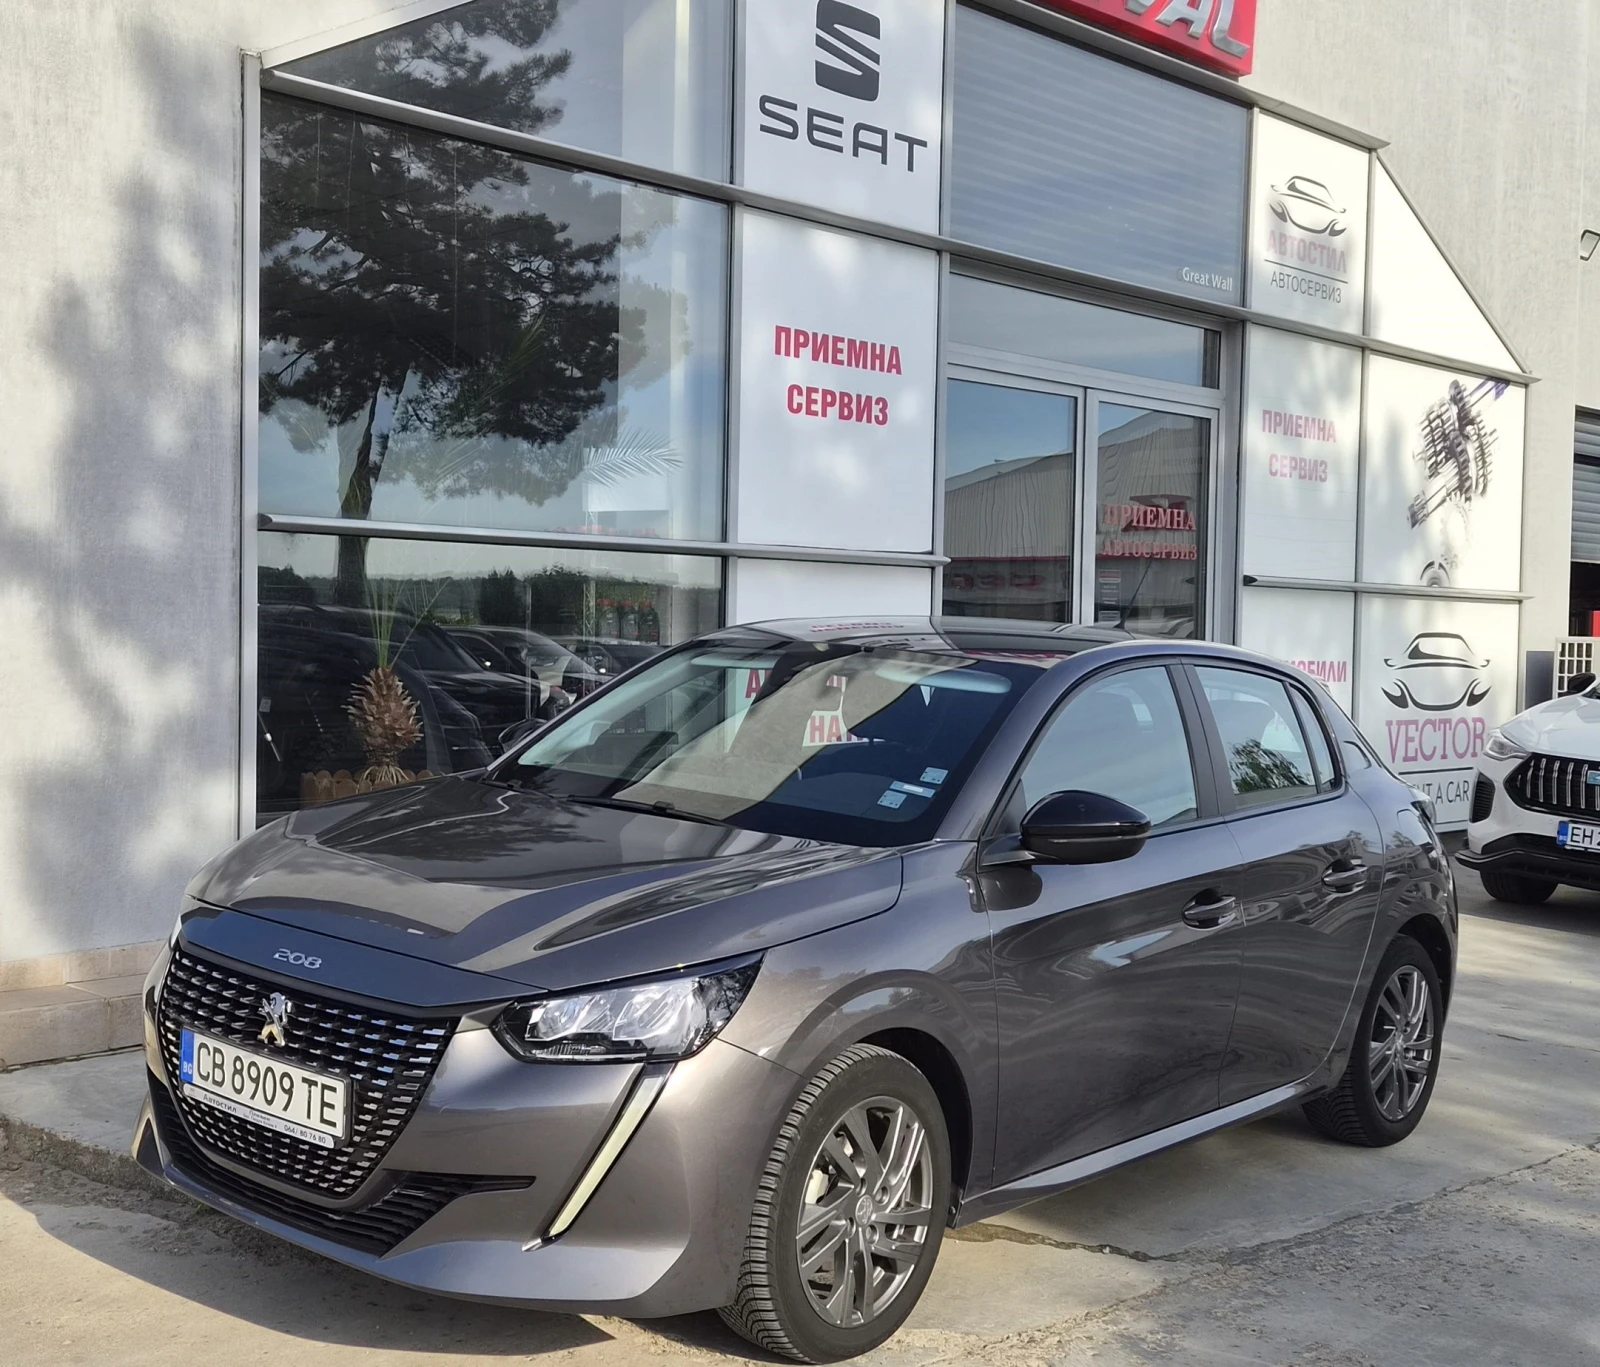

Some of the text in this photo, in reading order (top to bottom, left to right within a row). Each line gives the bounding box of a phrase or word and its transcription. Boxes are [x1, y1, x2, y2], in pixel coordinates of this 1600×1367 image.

[759, 94, 928, 173] SEAT
[1267, 229, 1348, 274] АВТОСТИЛ
[1182, 266, 1233, 292] Great Wall
[1270, 270, 1342, 304] АВТОСЕРВИЗ
[775, 325, 902, 376] ПРИЕМНА
[787, 383, 889, 427] СЕРВИЗ
[1262, 409, 1337, 444] ПРИЕМНА
[1268, 453, 1328, 484] СЕРВИЗ
[1104, 503, 1197, 530] ПРИЕМНА
[1103, 539, 1197, 560] АВТОСЕРВИЗ
[1386, 717, 1485, 764] VECTOR
[1435, 783, 1444, 804] A
[1446, 780, 1470, 804] CAR
[273, 948, 322, 969] 208
[182, 1061, 193, 1075] BG
[197, 1042, 337, 1127] CB 8909 TE
[203, 1094, 236, 1113] Автостил
[299, 1130, 308, 1138] 80
[309, 1133, 317, 1141] 76
[318, 1136, 327, 1144] 80
